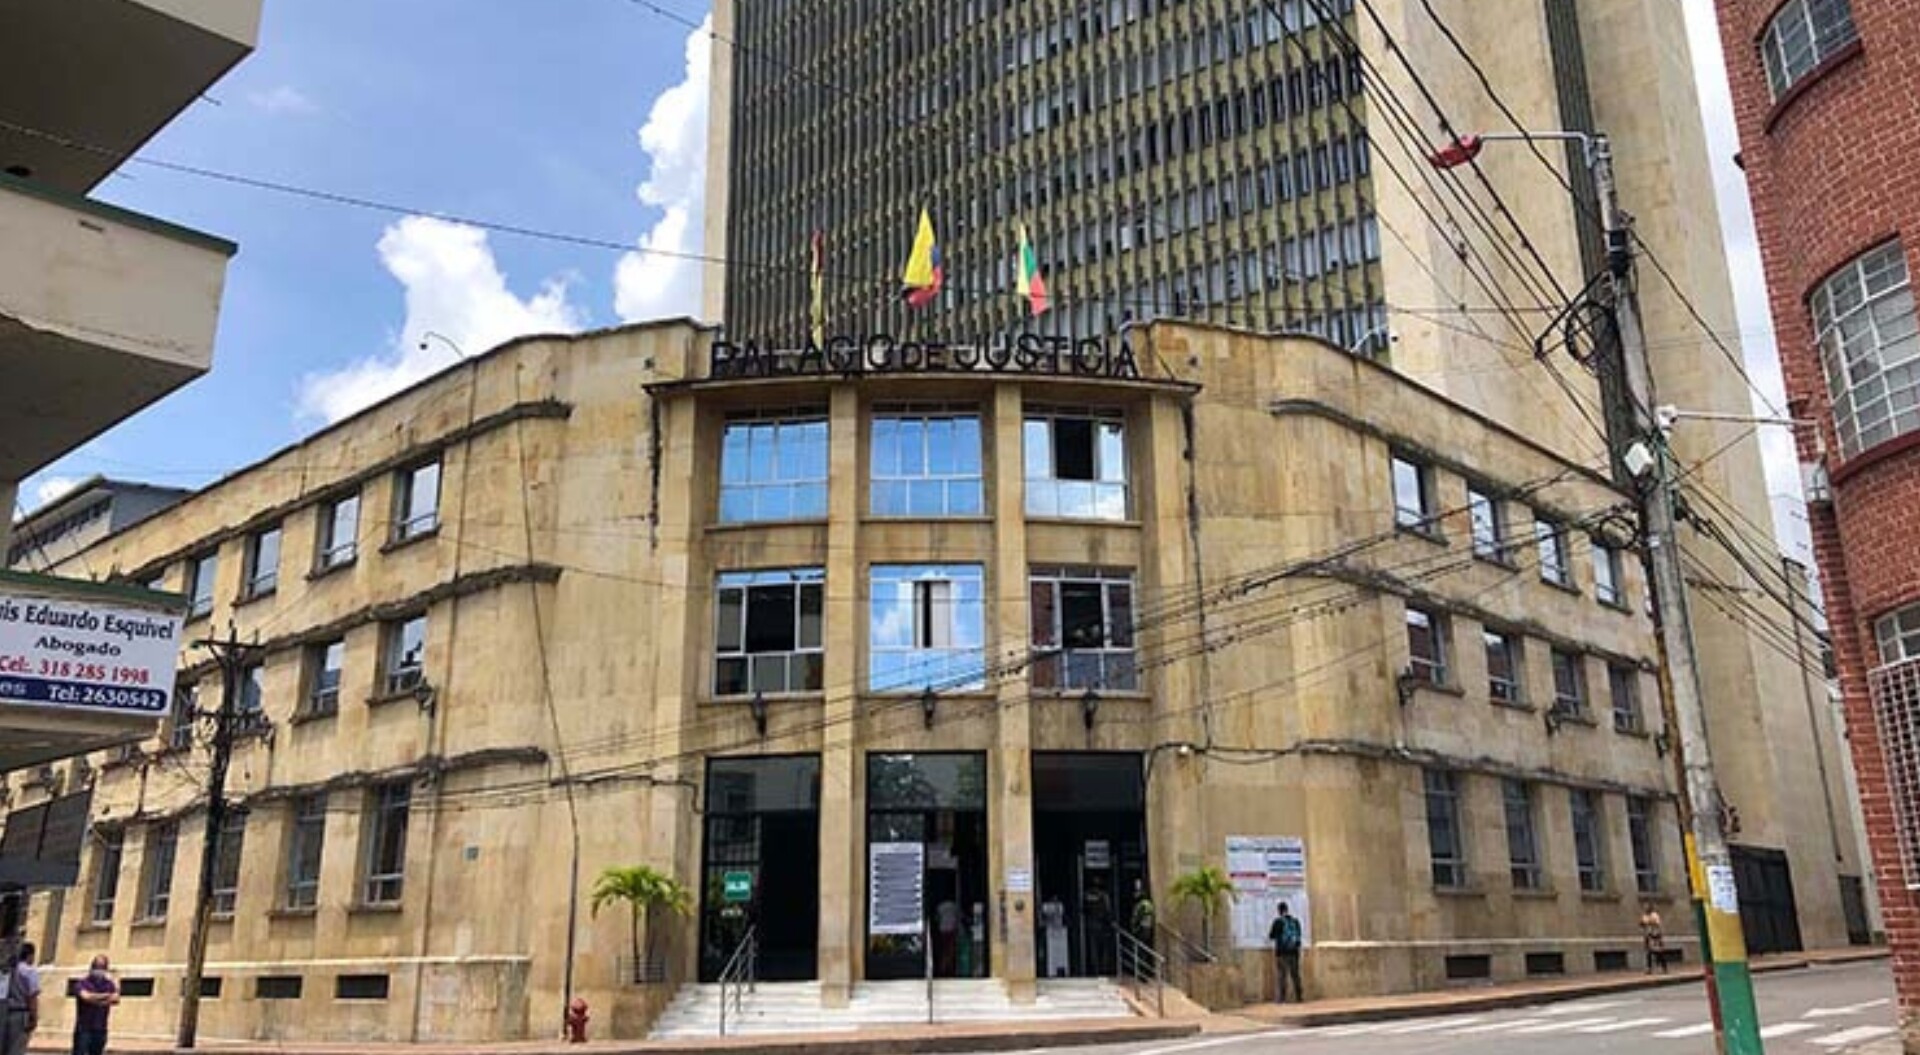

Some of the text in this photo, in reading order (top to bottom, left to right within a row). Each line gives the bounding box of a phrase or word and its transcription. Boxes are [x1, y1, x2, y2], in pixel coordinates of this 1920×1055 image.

[712, 334, 1139, 379] PALACIO DE JUSTICIA
[25, 605, 99, 631] Eduardo
[104, 615, 174, 641] Esquivel
[34, 636, 122, 656] Abogado
[39, 659, 70, 677] 318
[76, 664, 105, 681] 285
[112, 667, 150, 684] 1998
